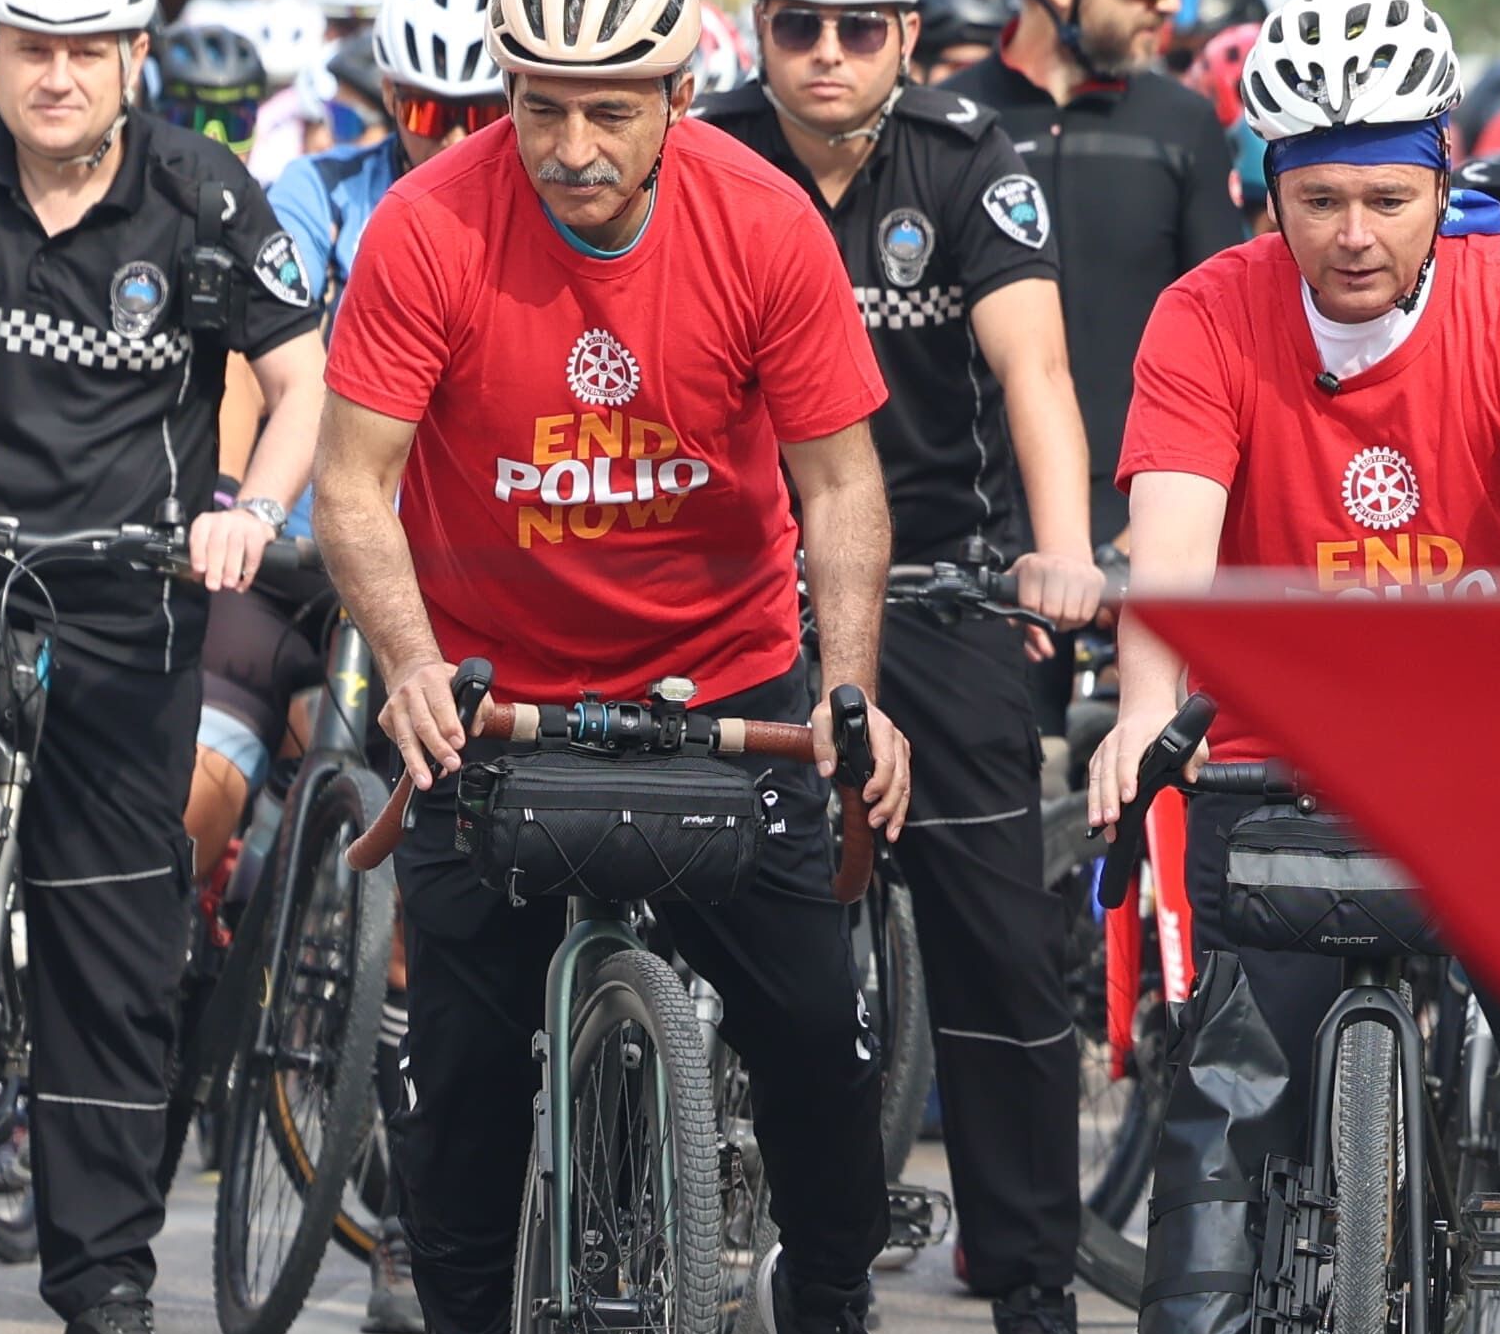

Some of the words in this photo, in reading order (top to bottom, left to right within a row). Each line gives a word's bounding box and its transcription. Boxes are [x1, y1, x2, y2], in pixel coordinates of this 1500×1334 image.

[532, 410, 678, 466] END
[495, 456, 709, 506] POLIO
[517, 496, 690, 549] NOW
[1316, 533, 1464, 592] END
